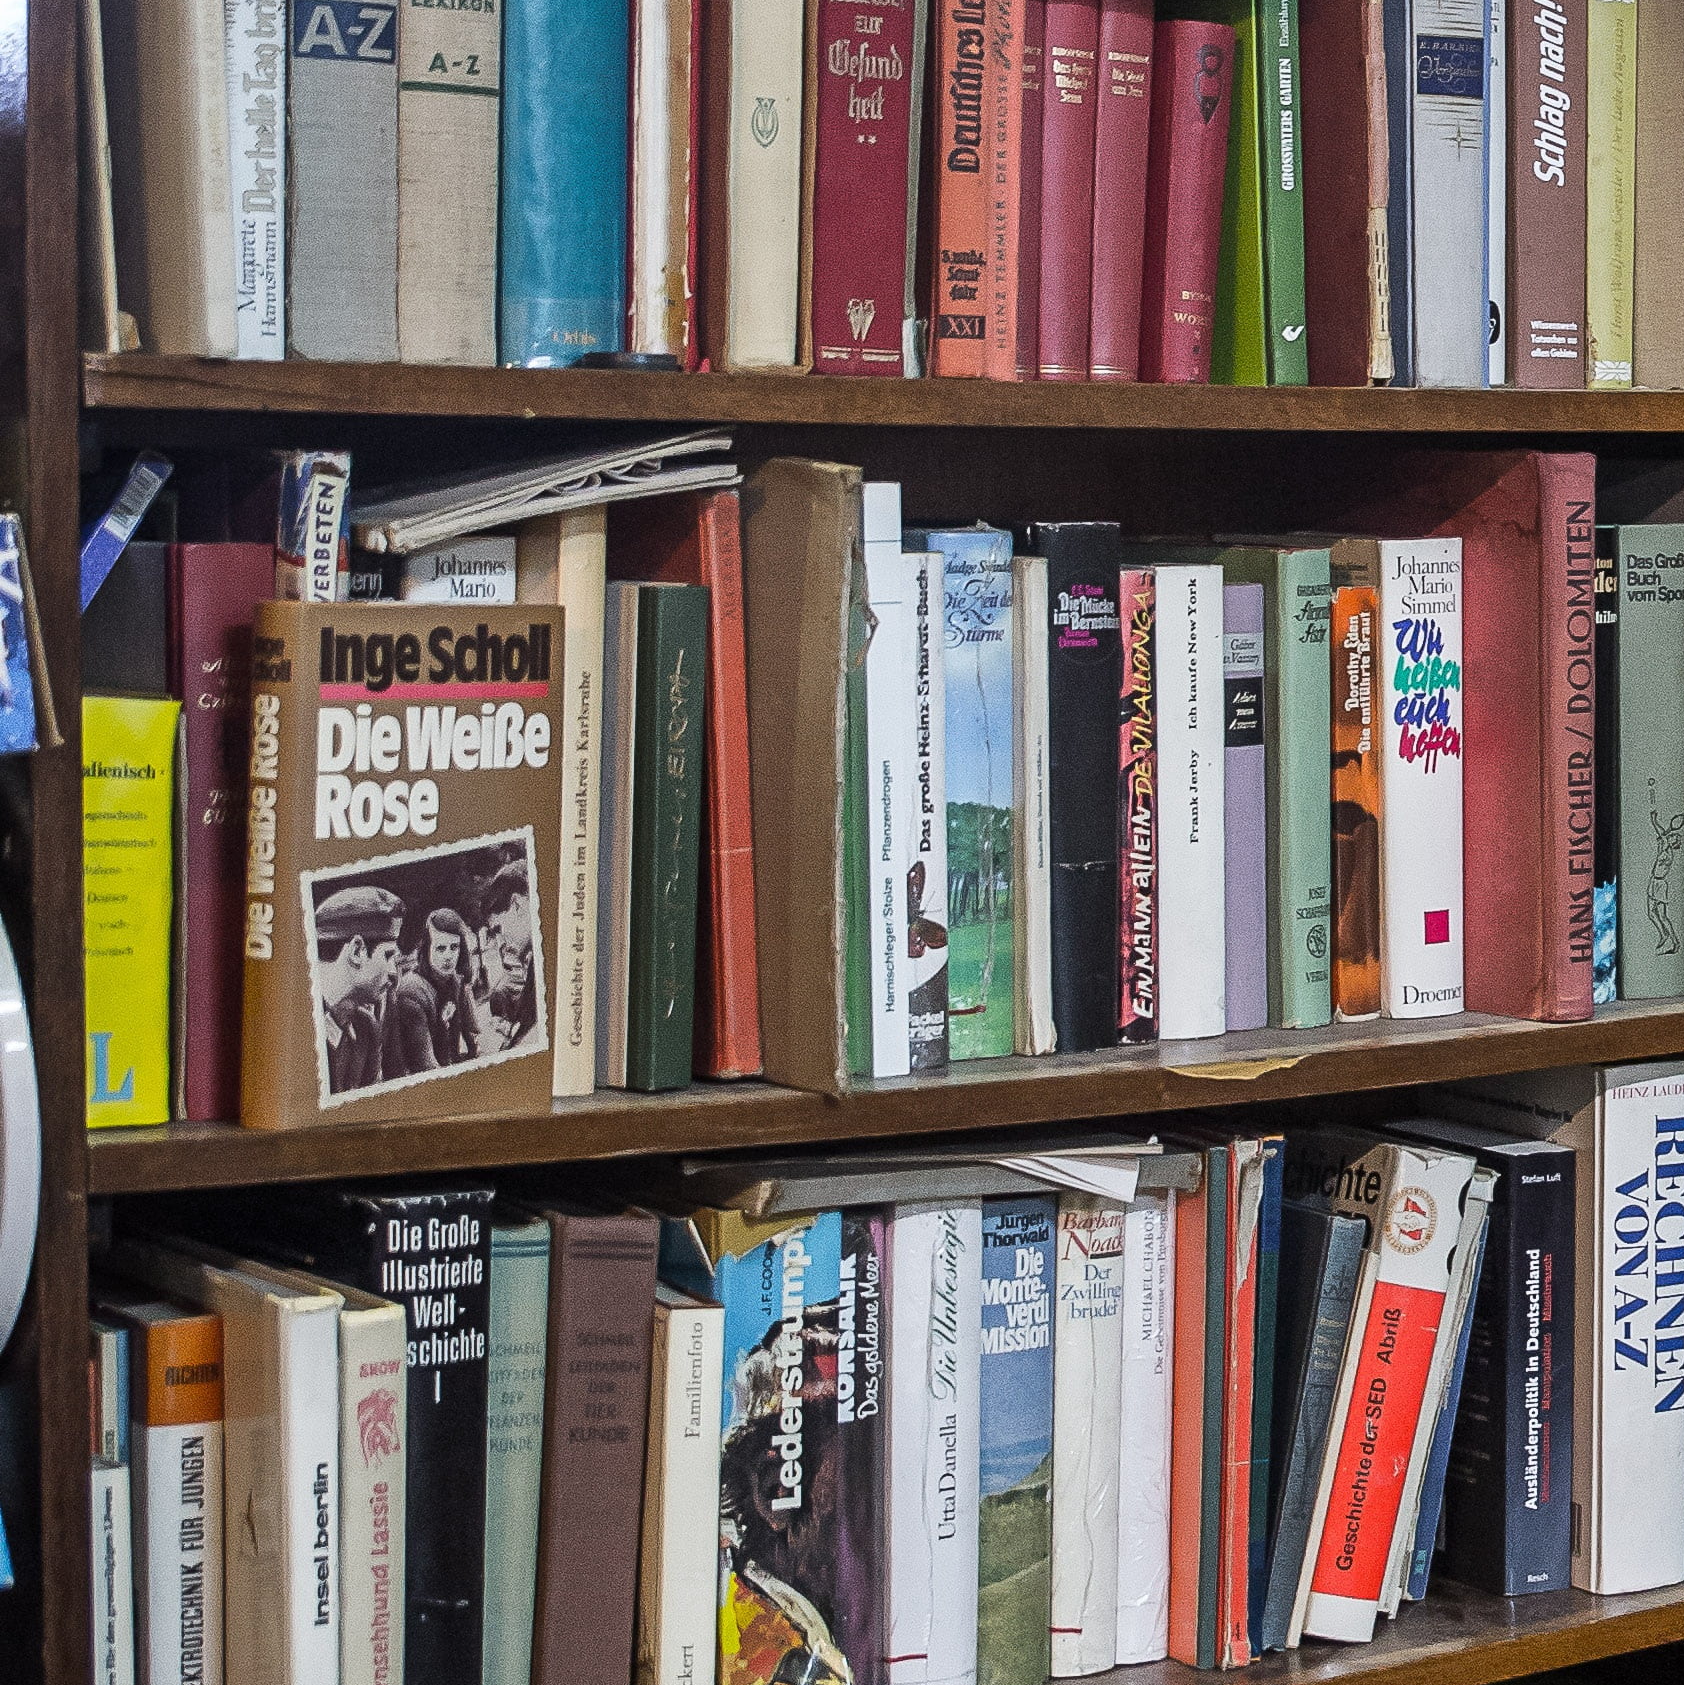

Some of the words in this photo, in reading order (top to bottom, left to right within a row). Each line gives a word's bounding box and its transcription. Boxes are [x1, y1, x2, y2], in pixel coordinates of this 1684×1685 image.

[298, 4, 395, 62] A-Z
[428, 51, 481, 78] A-Z
[1533, 92, 1573, 187] Schlag
[944, 315, 984, 340] XXI
[430, 554, 508, 581] Johannes
[449, 577, 496, 599] Mario
[1395, 555, 1461, 580] Johannes
[1408, 577, 1453, 595] Mario
[1626, 571, 1662, 588] Buch
[1400, 595, 1457, 615] Simmel
[1567, 500, 1592, 723] DOLOMITEN
[319, 627, 421, 692] Inge
[428, 623, 551, 682] Scholl
[255, 693, 281, 776] Rose
[318, 705, 403, 774] Die
[408, 702, 551, 771] Weiße
[315, 773, 439, 842] Rose
[880, 760, 894, 863] Pflanzendrogen
[1569, 753, 1592, 879] FISCHER
[249, 780, 277, 903] Weiße
[247, 910, 274, 961] Die
[1570, 885, 1592, 965] HANS
[1402, 984, 1462, 1008] Droemer
[89, 1031, 135, 1105] L
[1611, 1085, 1650, 1102] HEINZ
[386, 1218, 423, 1254] Die
[427, 1215, 482, 1248] Große
[981, 1225, 1050, 1248] Thorwald
[996, 1209, 1046, 1234] Jürgen
[1615, 1167, 1650, 1278] VON
[381, 1258, 485, 1294] Illustrierte
[1014, 1247, 1047, 1279] Die
[836, 1253, 857, 1424] KONSALIK
[980, 1322, 1050, 1353] Mission
[1004, 1299, 1049, 1329] verdi
[1612, 1281, 1650, 1373] A-Z
[684, 1321, 702, 1440] Familienfoto
[313, 1461, 331, 1546] berlin
[370, 1481, 390, 1559] Lassie
[314, 1548, 331, 1627] Insel
